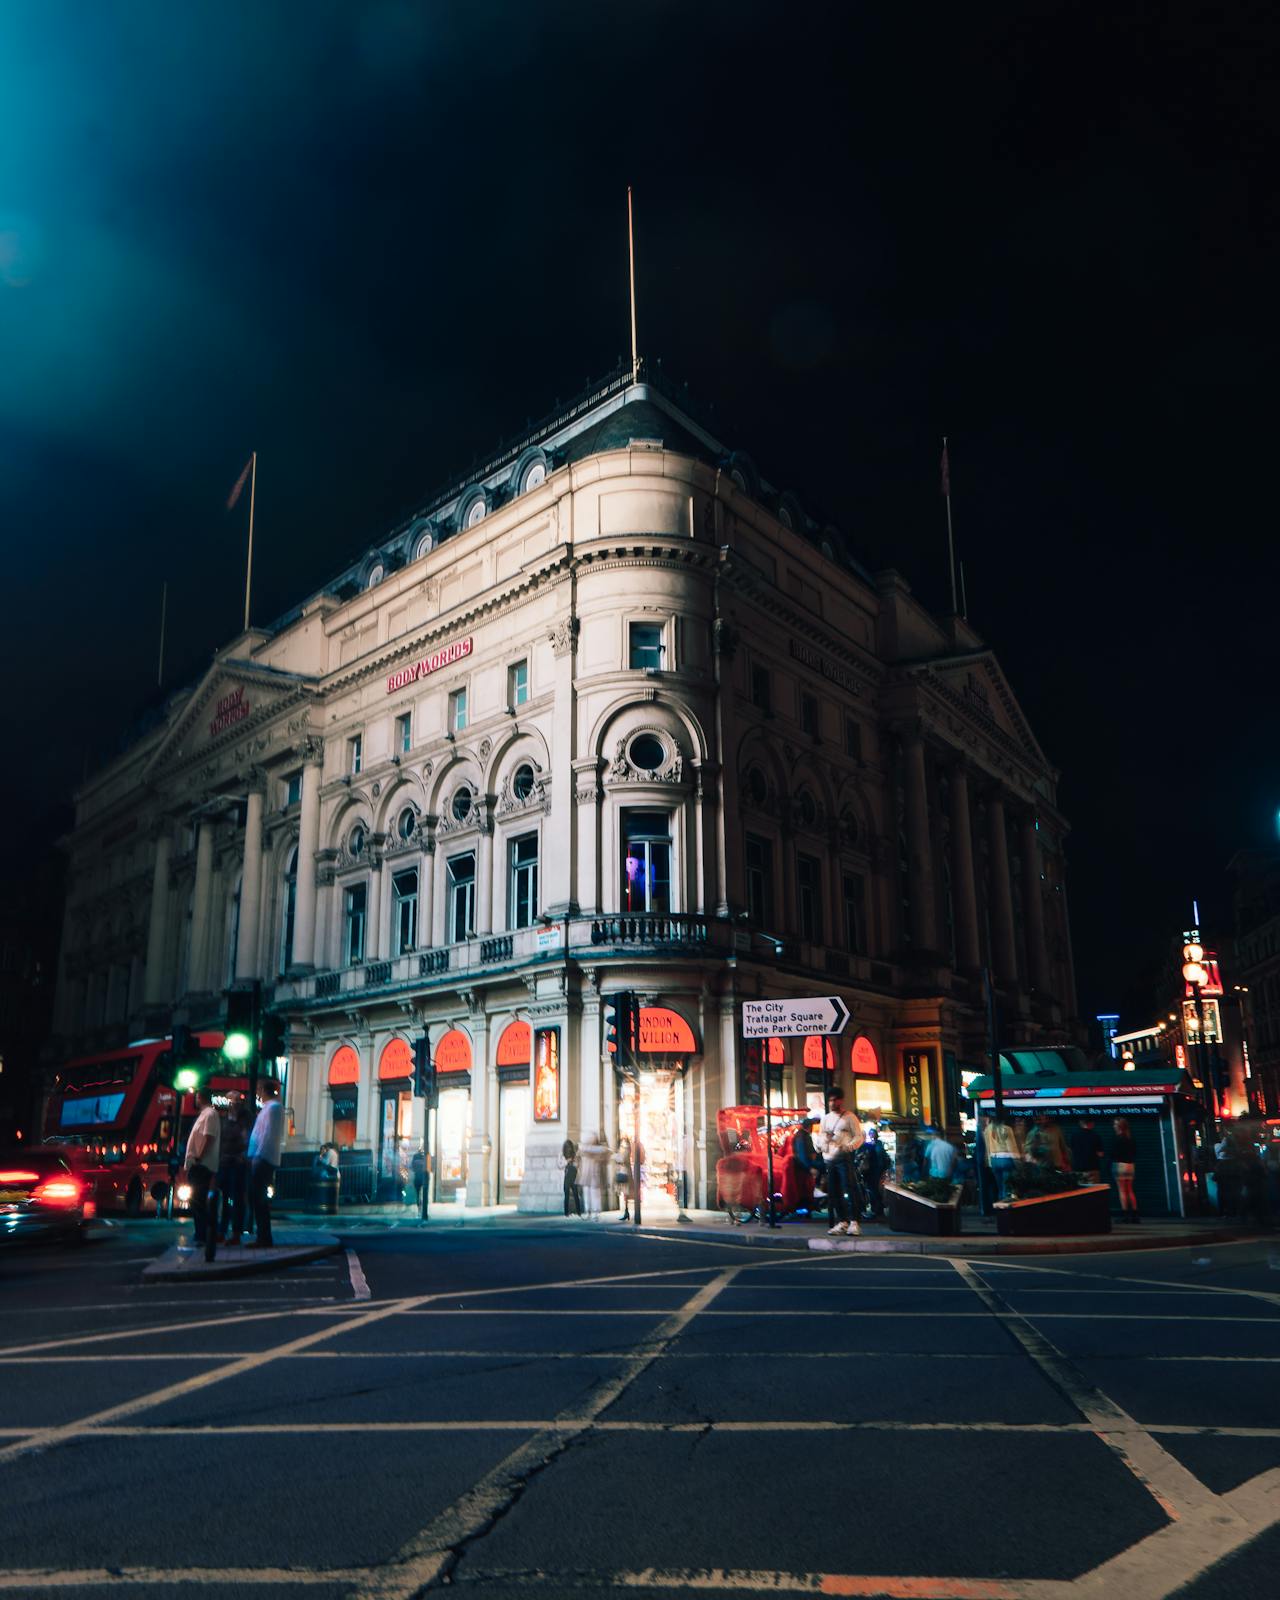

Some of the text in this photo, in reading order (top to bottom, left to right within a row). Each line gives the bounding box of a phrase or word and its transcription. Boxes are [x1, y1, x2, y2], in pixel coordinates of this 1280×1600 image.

[746, 1003, 784, 1013] The City
[639, 1016, 672, 1029] ONDON
[746, 1012, 824, 1024] Trafalgar Square
[746, 1023, 828, 1036] Hyde Park Corner
[639, 1032, 680, 1045] VILION
[909, 1055, 920, 1117] TOBACC
